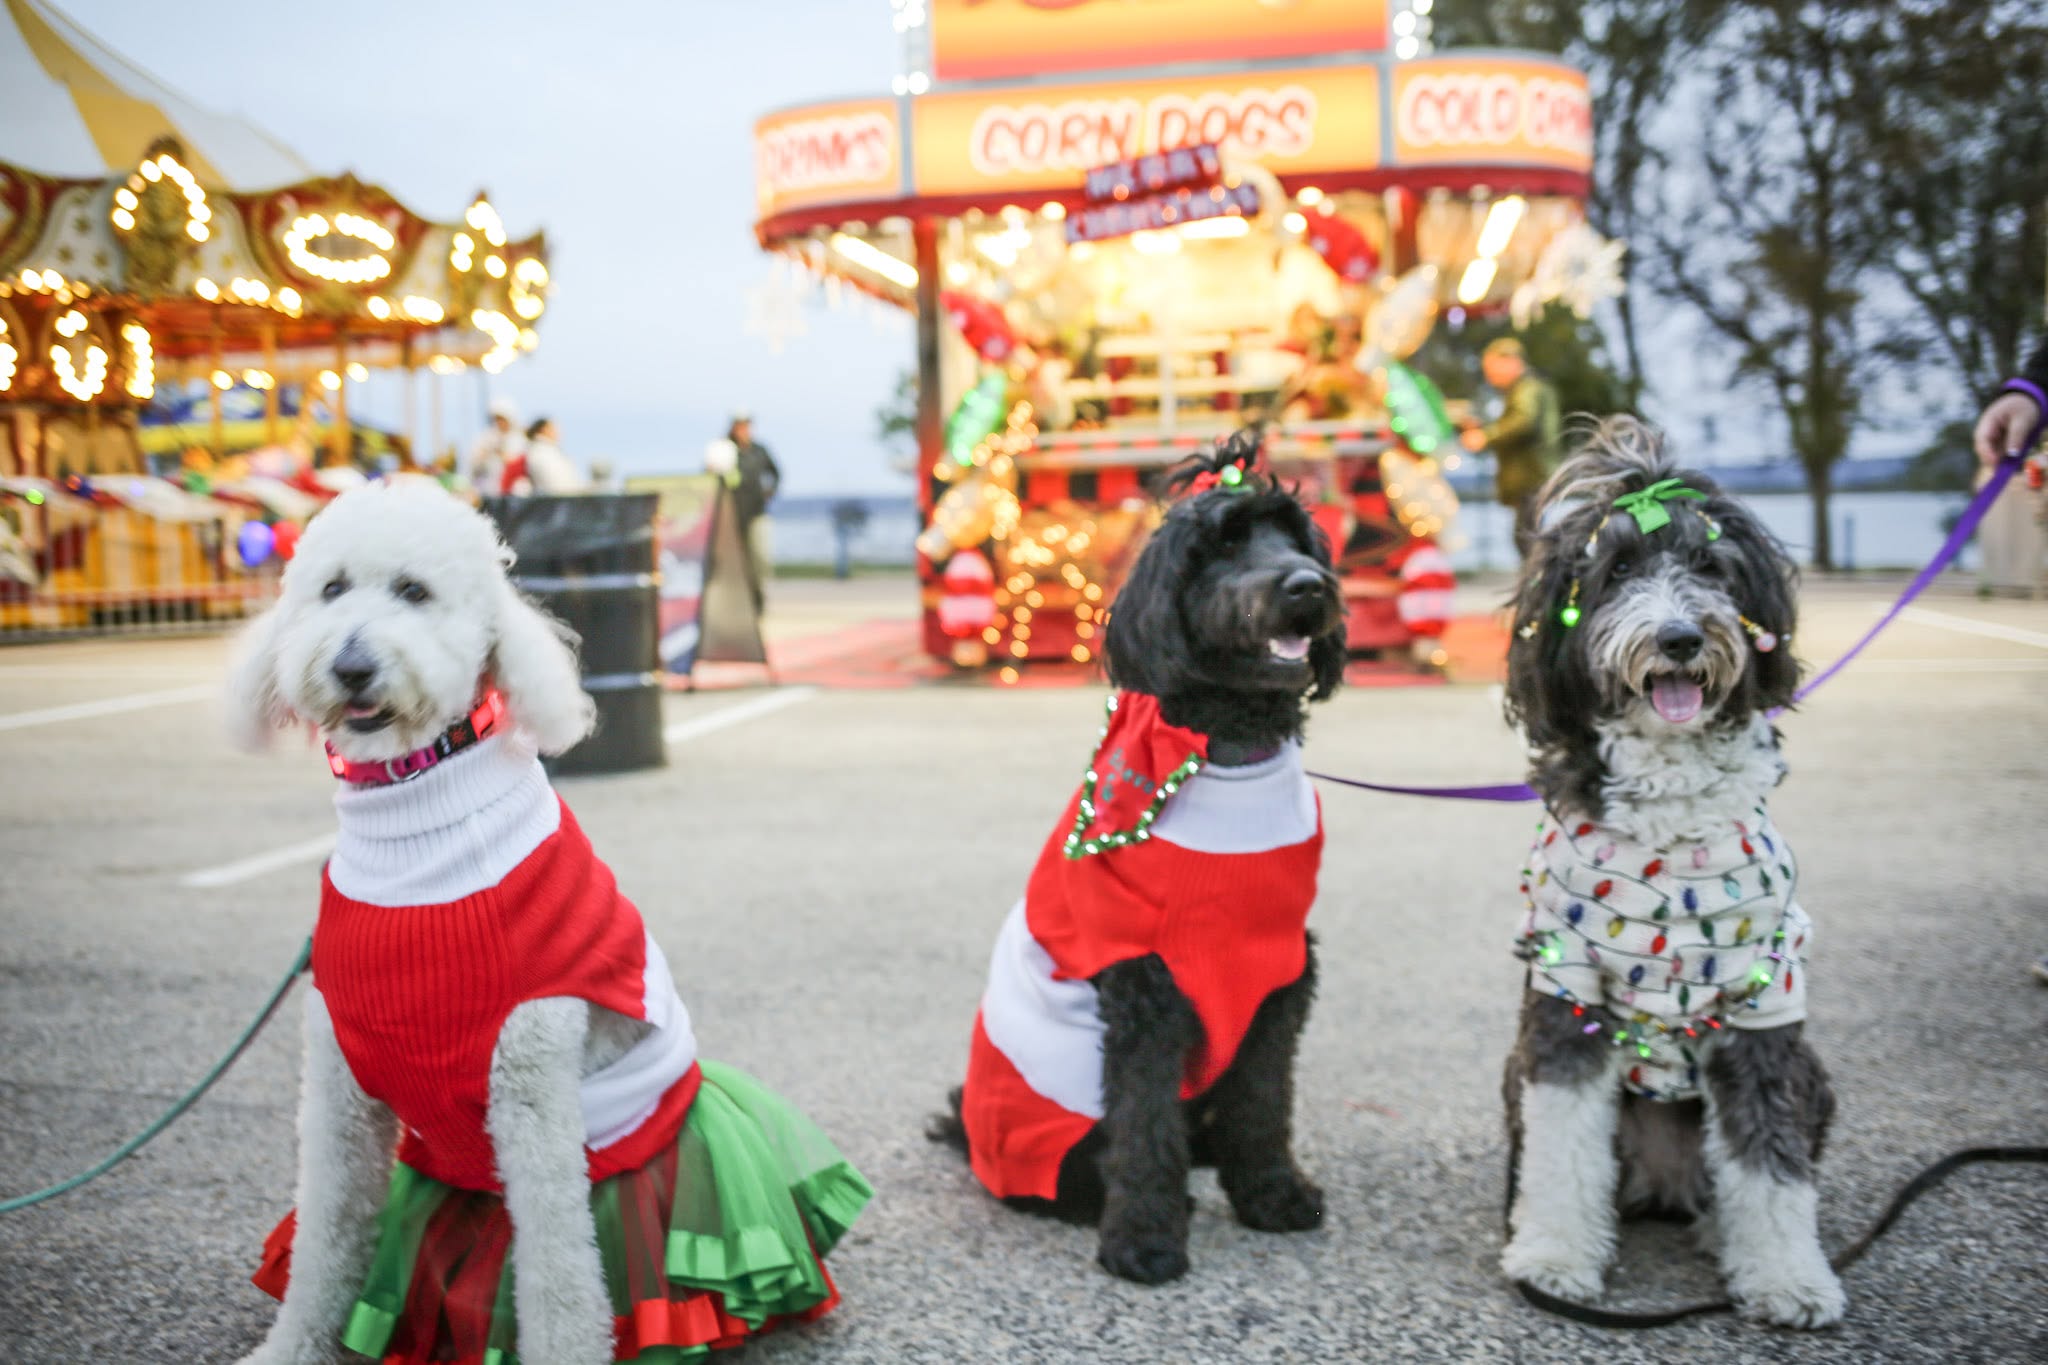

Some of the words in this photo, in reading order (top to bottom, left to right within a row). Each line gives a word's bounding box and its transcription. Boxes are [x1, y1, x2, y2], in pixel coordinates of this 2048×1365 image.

[973, 102, 1142, 171] CORN
[1149, 86, 1313, 155] DOGS
[1402, 77, 1521, 144] COLD
